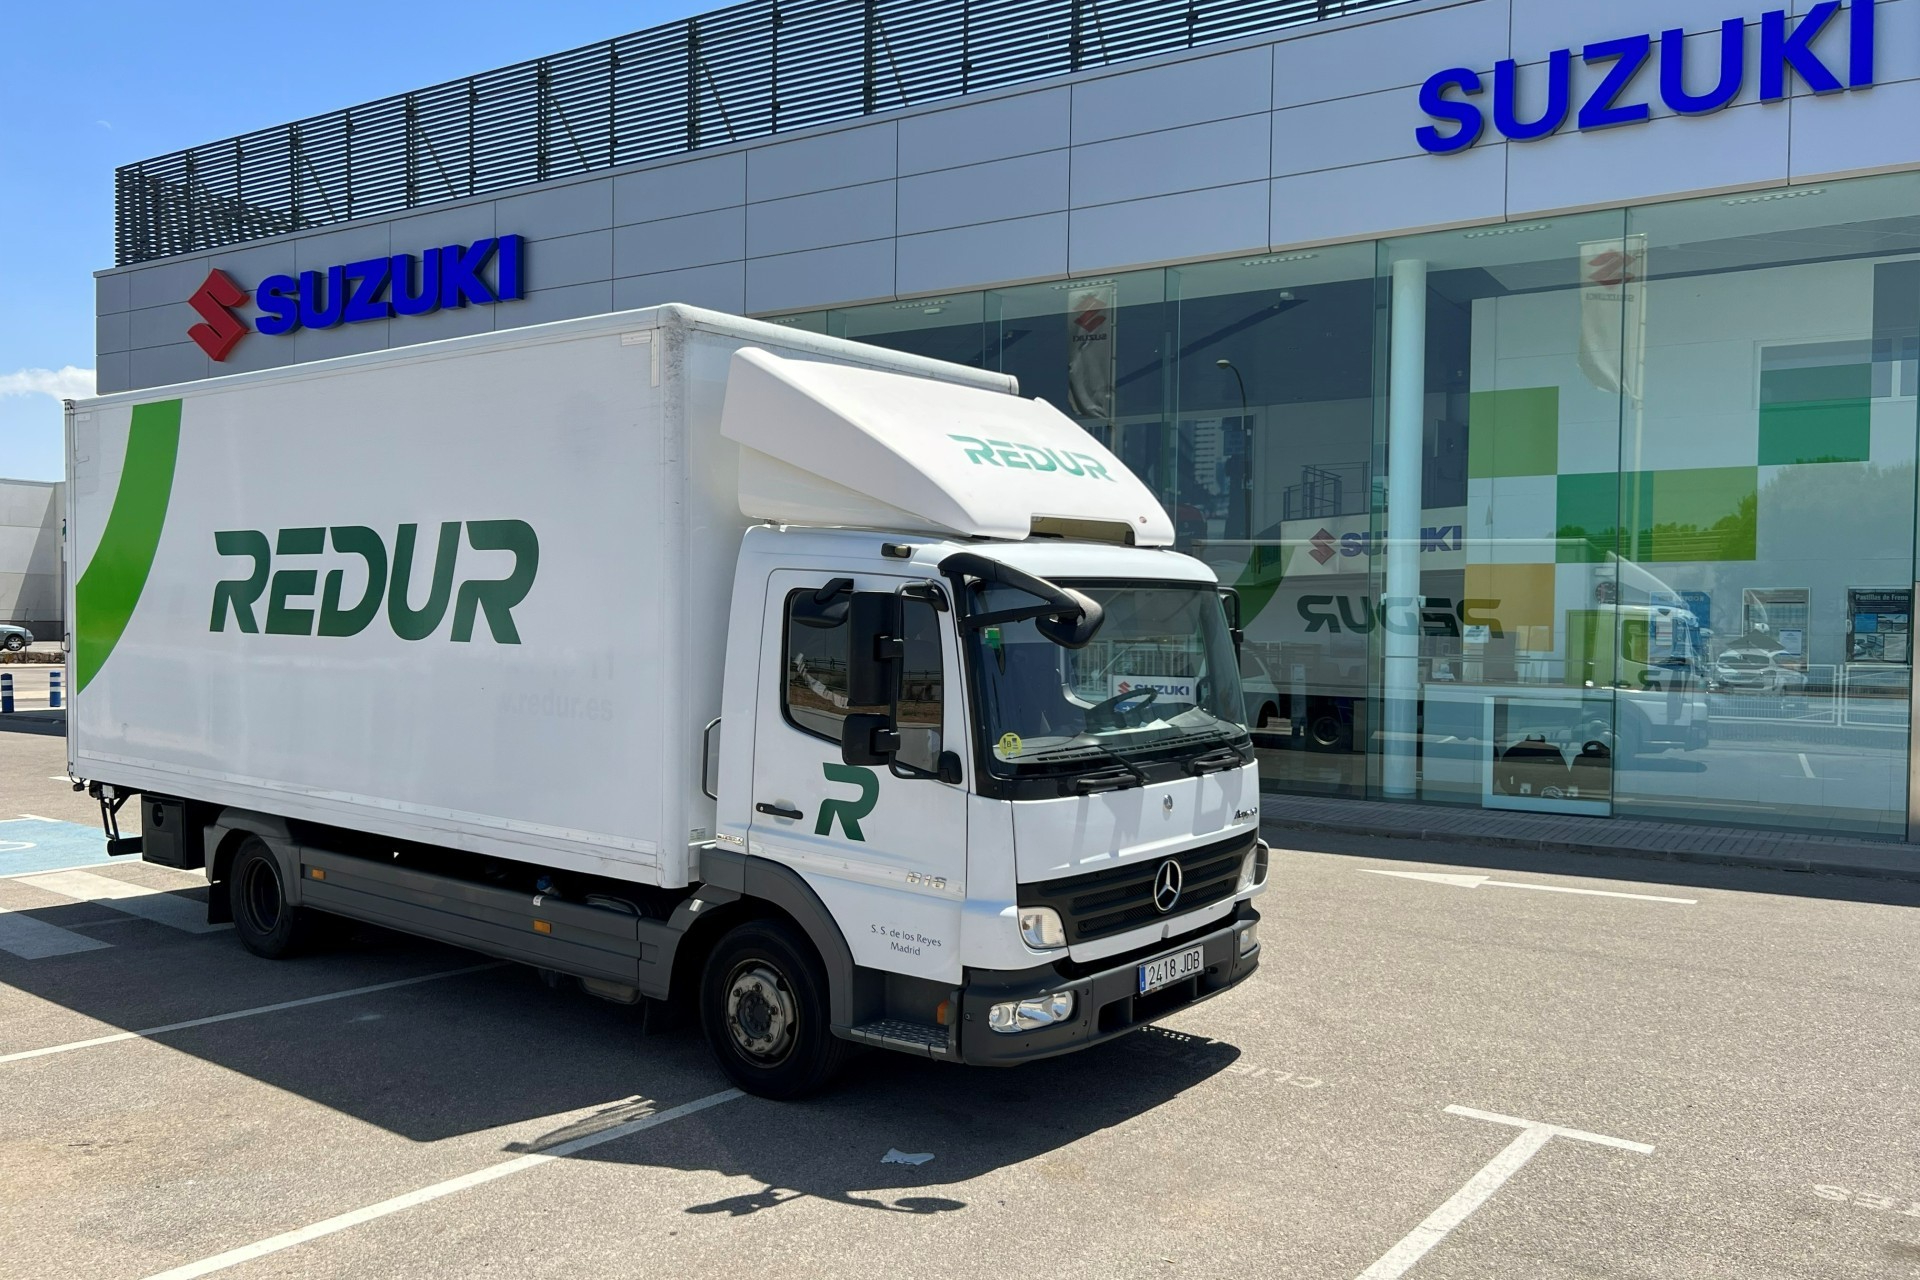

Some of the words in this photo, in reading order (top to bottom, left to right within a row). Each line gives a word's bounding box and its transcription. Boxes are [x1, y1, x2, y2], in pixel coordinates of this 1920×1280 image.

[1415, 0, 1875, 156] SUZUKI
[255, 234, 525, 335] SUZUKI
[945, 434, 1119, 483] REDUR
[1340, 525, 1462, 557] SUKI
[209, 519, 539, 644] REDUR
[814, 762, 879, 841] R
[871, 924, 879, 934] S.
[880, 926, 888, 936] S.
[890, 929, 901, 939] de
[902, 931, 915, 941] los
[916, 933, 942, 947] Reyes
[890, 941, 921, 956] Madrid
[1148, 958, 1177, 986] 2418
[1180, 950, 1200, 973] JDB
